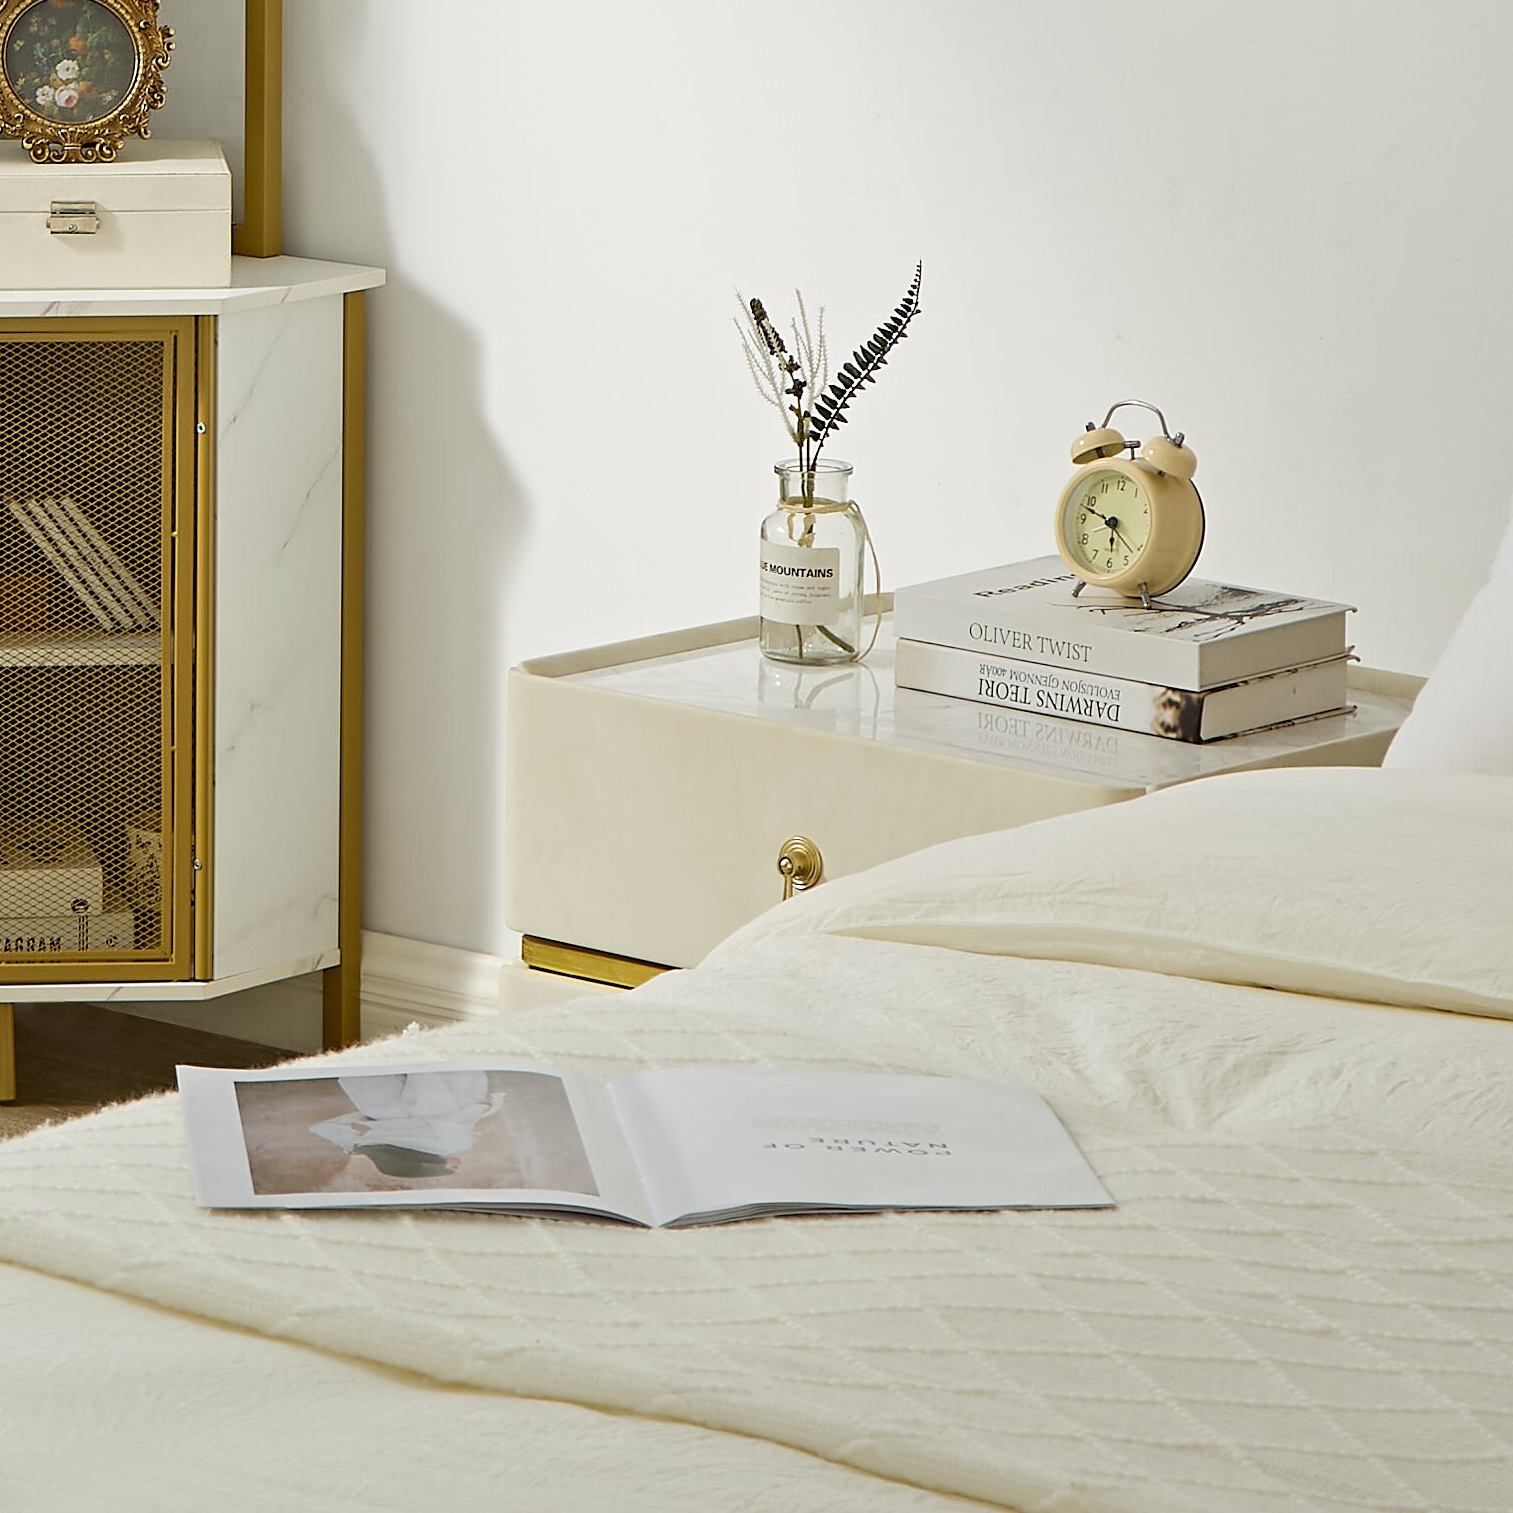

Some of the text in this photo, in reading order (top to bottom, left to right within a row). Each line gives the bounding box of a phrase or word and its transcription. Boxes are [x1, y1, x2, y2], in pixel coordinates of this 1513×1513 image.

[1101, 483, 1109, 494] 11
[1117, 480, 1126, 491] 12
[1086, 496, 1097, 507] 10
[1080, 513, 1087, 524] 9
[1081, 533, 1089, 545] 8
[1092, 549, 1099, 560] 7
[1123, 555, 1129, 566] 5
[1106, 557, 1113, 569] 6
[769, 564, 834, 578] MOUNTAINS
[969, 622, 1092, 662] OLIVER TWIST
[1009, 669, 1060, 688] GJENNOM
[1062, 680, 1121, 700] EVOLUSJON
[978, 678, 1121, 722] DARWINS TEORI
[808, 1137, 949, 1149] NATURE
[827, 1145, 952, 1156] POWER
